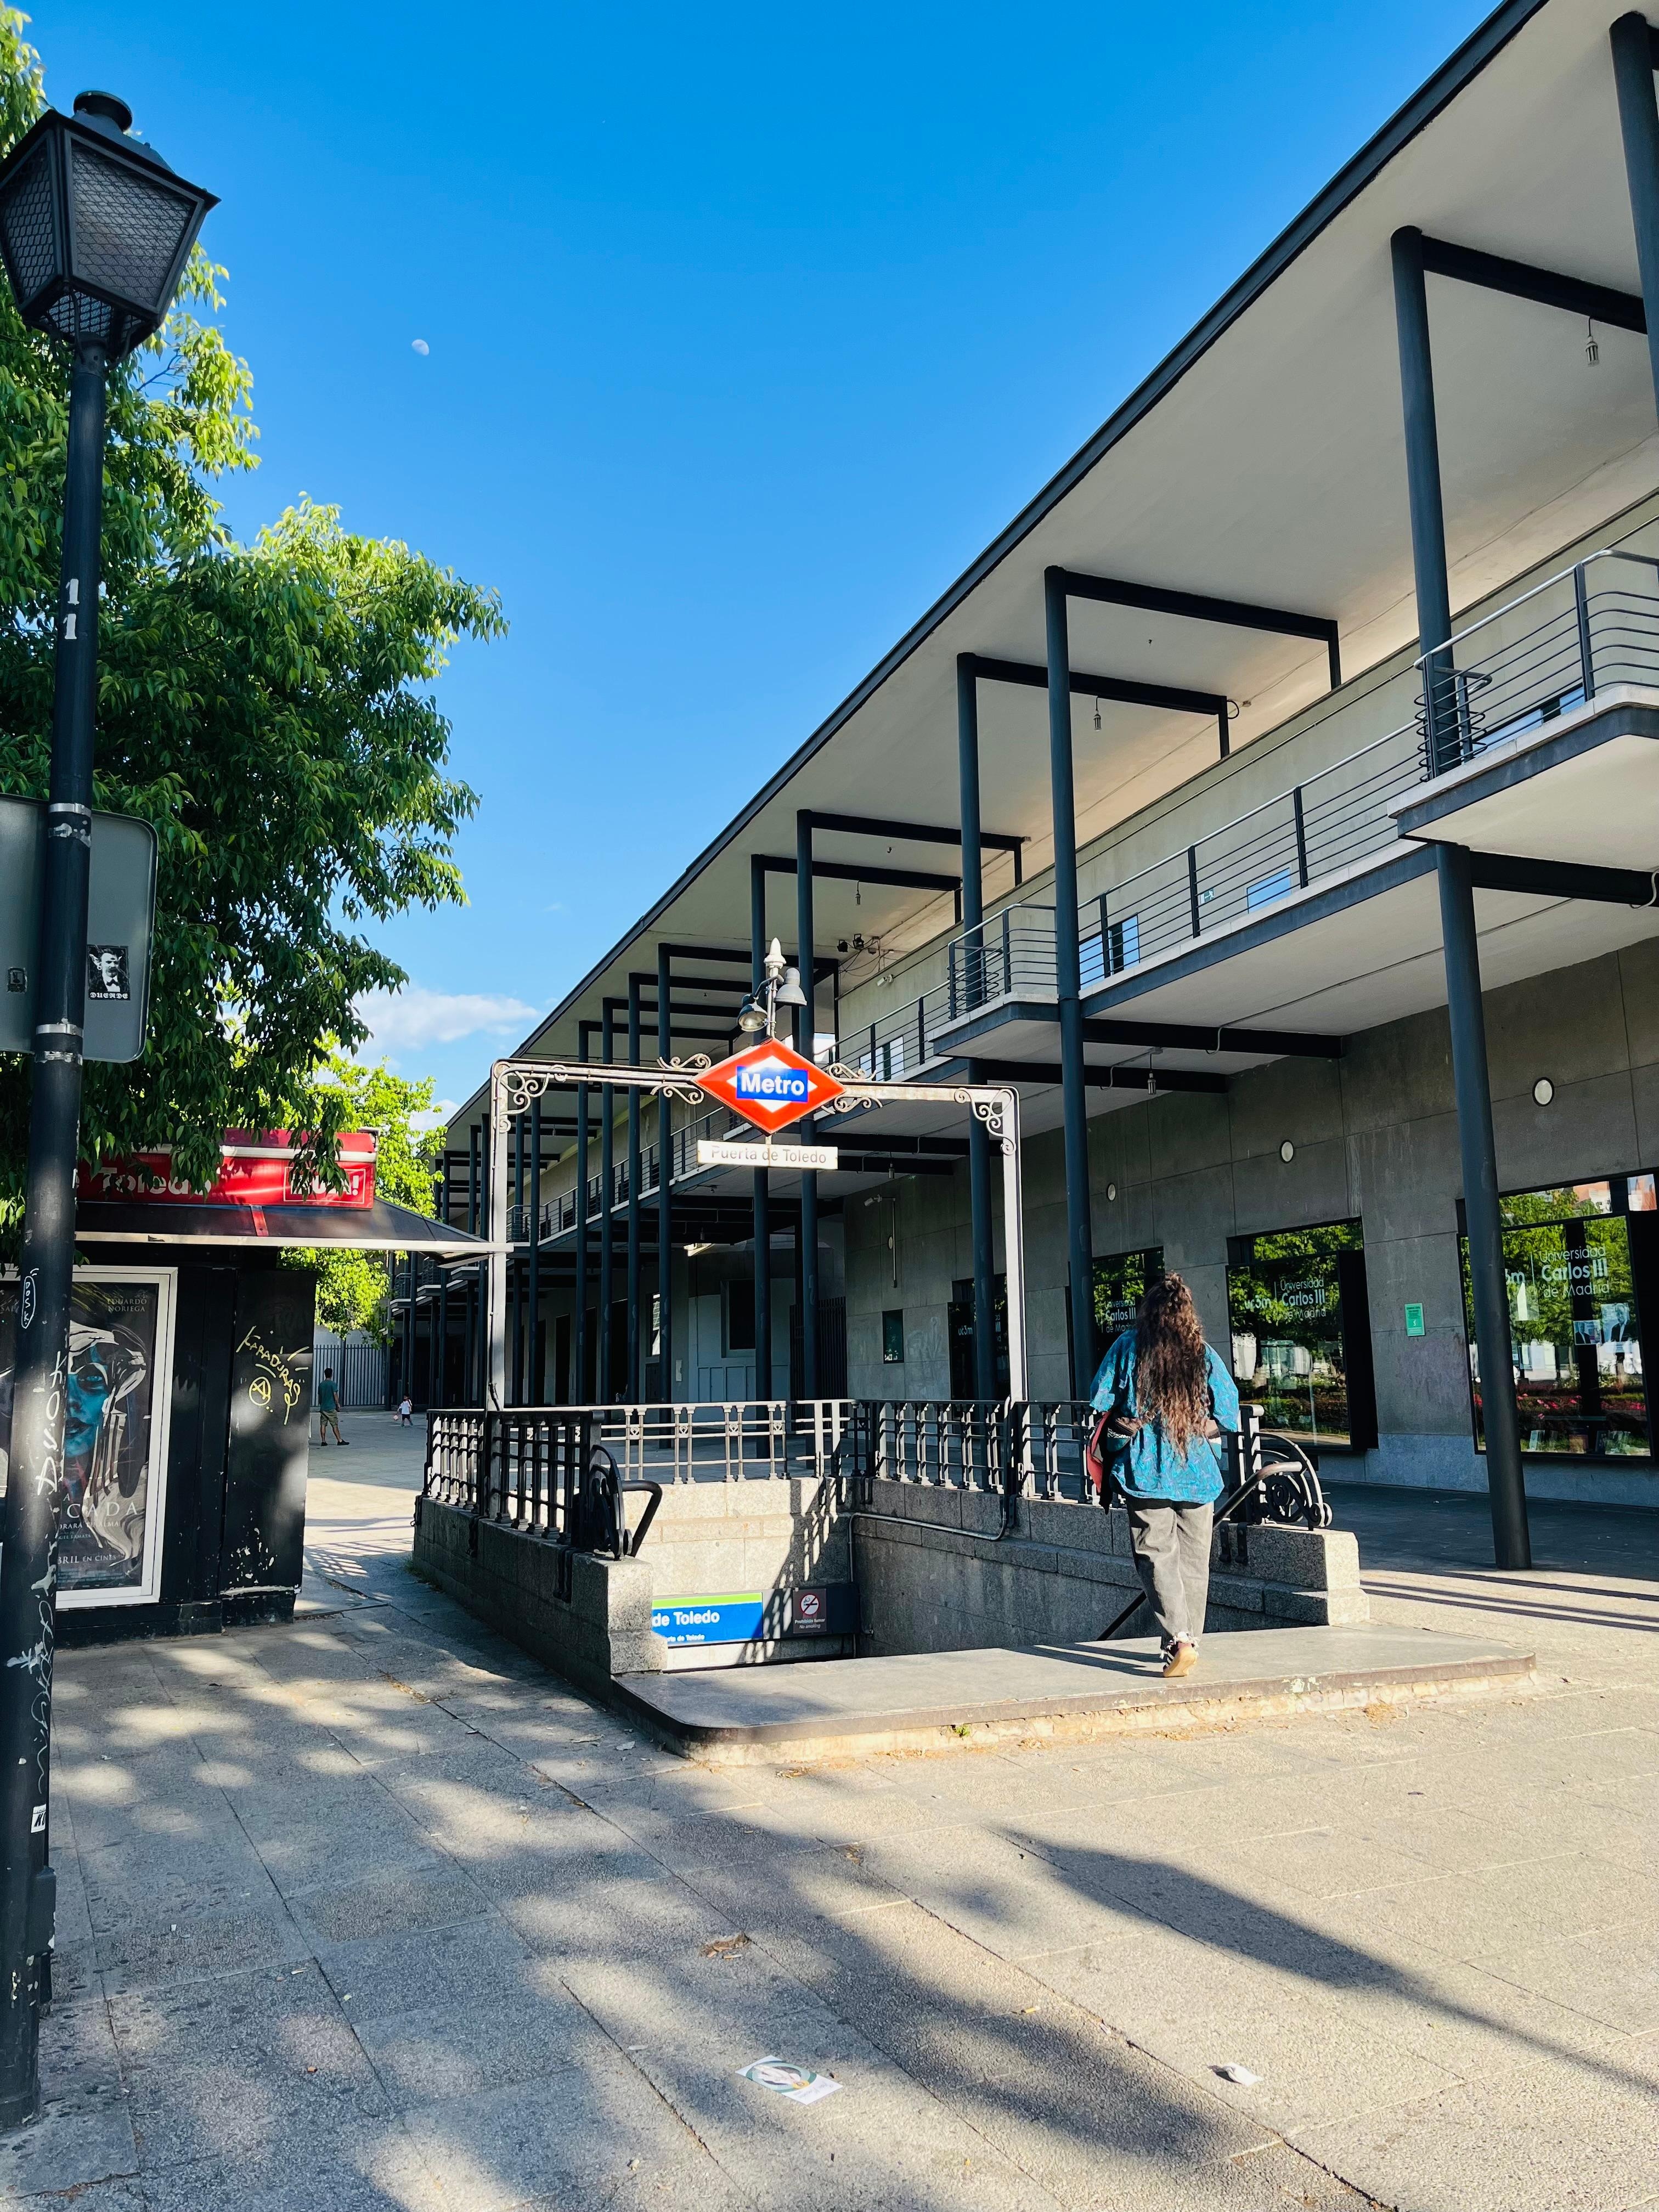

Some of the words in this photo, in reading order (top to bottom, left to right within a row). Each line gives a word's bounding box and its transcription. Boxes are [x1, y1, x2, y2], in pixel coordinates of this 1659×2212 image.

[741, 1073, 805, 1095] Metro
[711, 1145, 757, 1160] Puerta
[762, 1148, 778, 1161] de
[782, 1149, 826, 1164] Toledo
[1539, 1244, 1606, 1263] Universidad
[1542, 1262, 1590, 1282] Carlos
[1280, 1277, 1324, 1291] Universidad
[1543, 1285, 1559, 1298] de
[1563, 1280, 1610, 1297] Madrid
[1282, 1291, 1314, 1306] Carlos
[1105, 1309, 1128, 1322] Carlos
[58, 1555, 80, 1564] BRIL
[652, 1612, 670, 1627] de
[673, 1609, 720, 1625] Toledo
